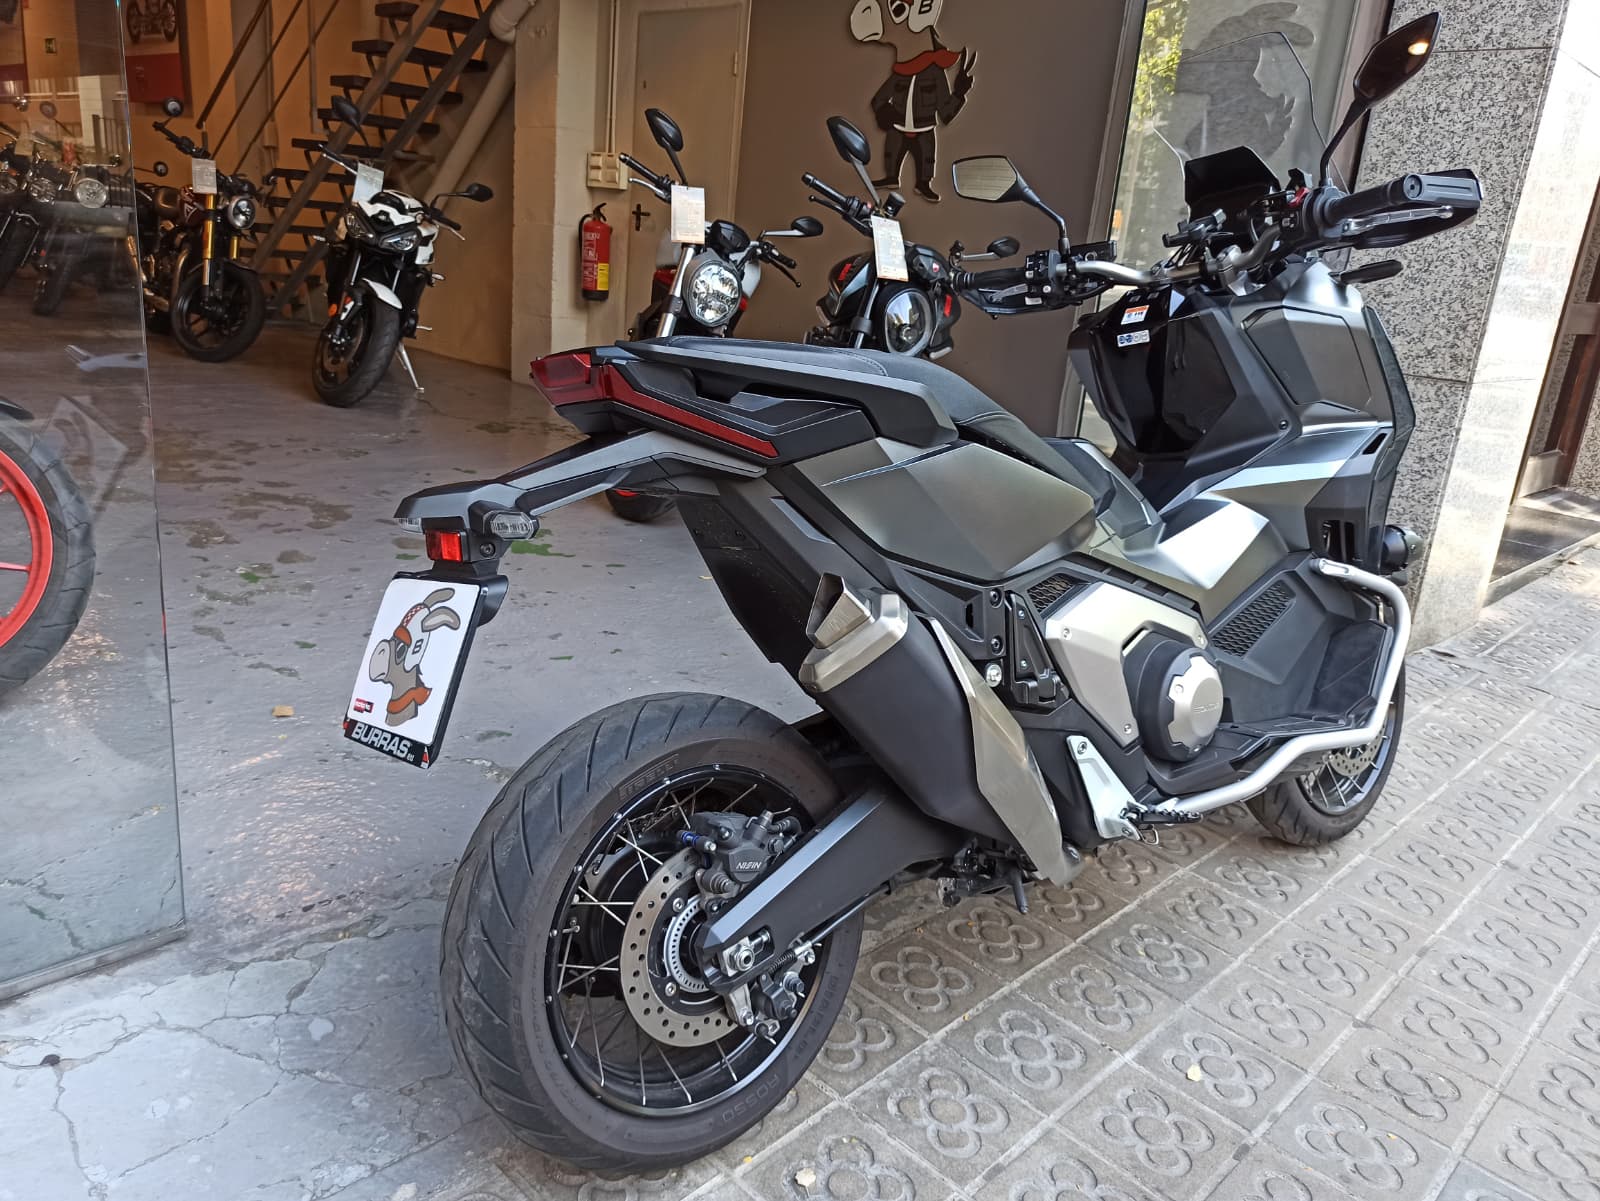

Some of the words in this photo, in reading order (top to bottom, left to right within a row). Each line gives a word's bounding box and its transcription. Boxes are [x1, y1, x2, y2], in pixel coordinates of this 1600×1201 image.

[918, 0, 933, 15] B
[412, 638, 424, 655] B
[351, 722, 412, 758] BURRAS
